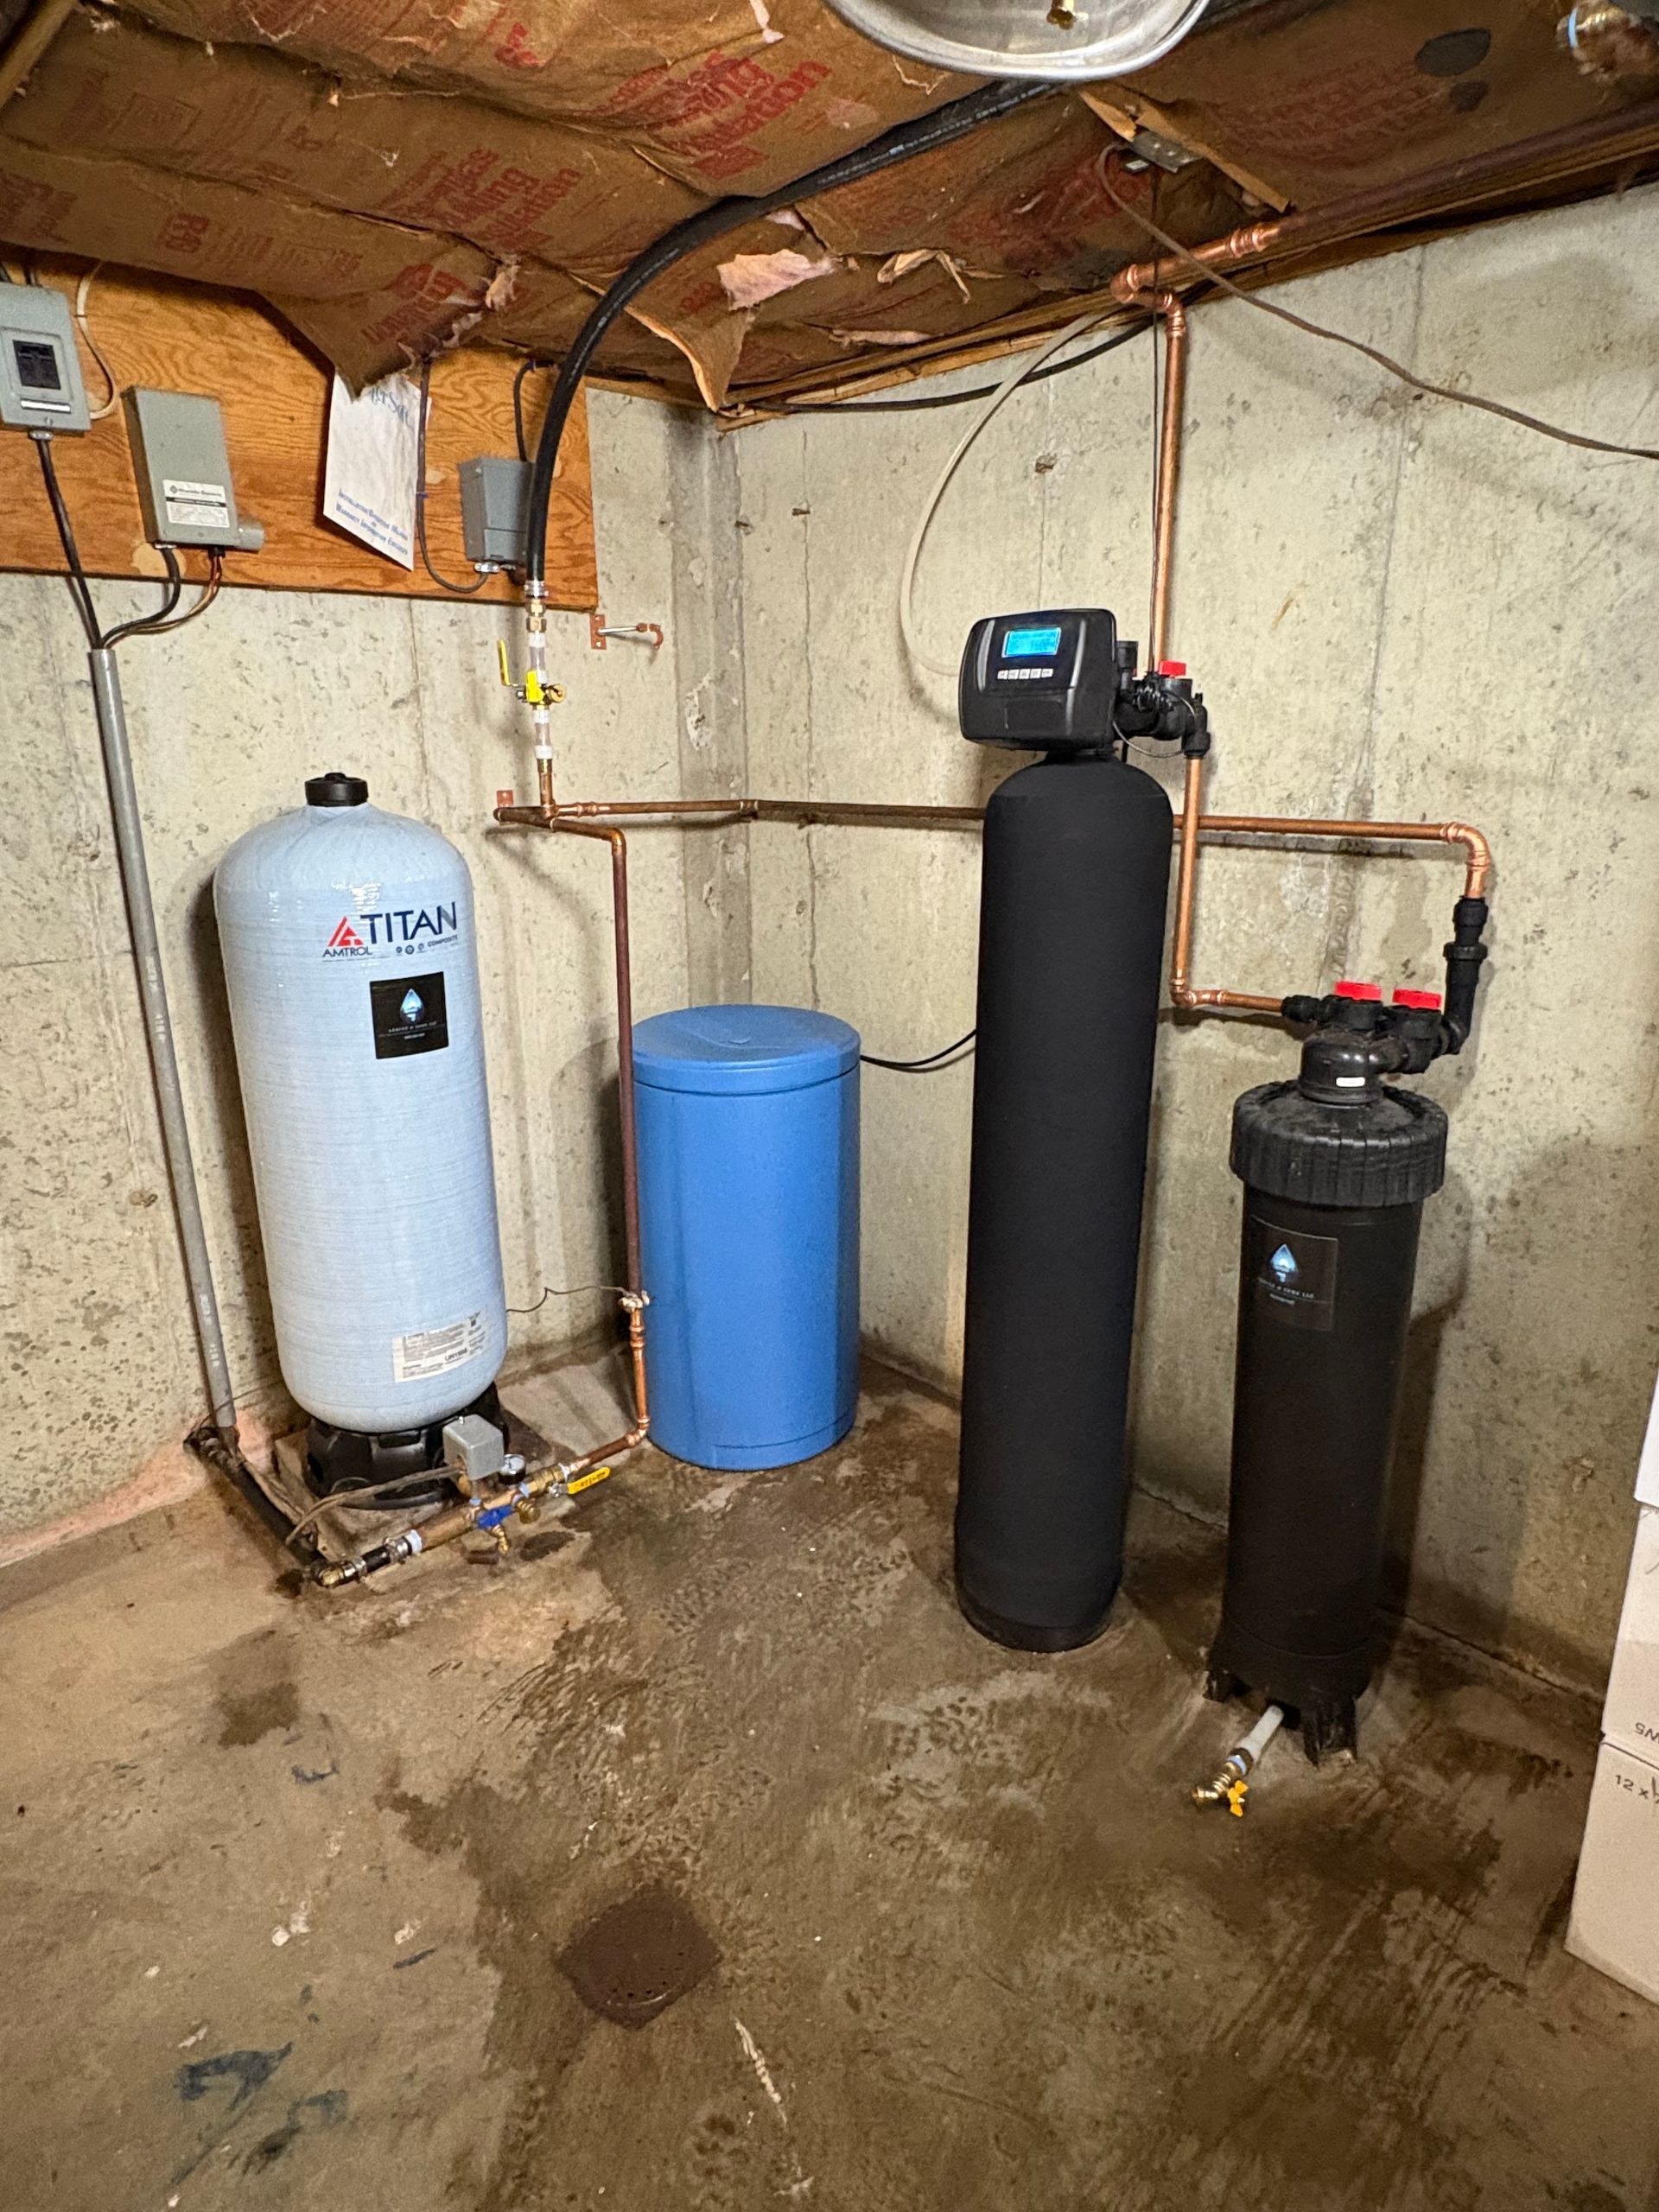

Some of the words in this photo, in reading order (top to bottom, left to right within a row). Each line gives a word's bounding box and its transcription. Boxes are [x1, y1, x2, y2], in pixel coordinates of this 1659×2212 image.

[359, 901, 458, 944] TITAN
[427, 934, 458, 947] COMPOSITE
[321, 945, 372, 958] AMTROL
